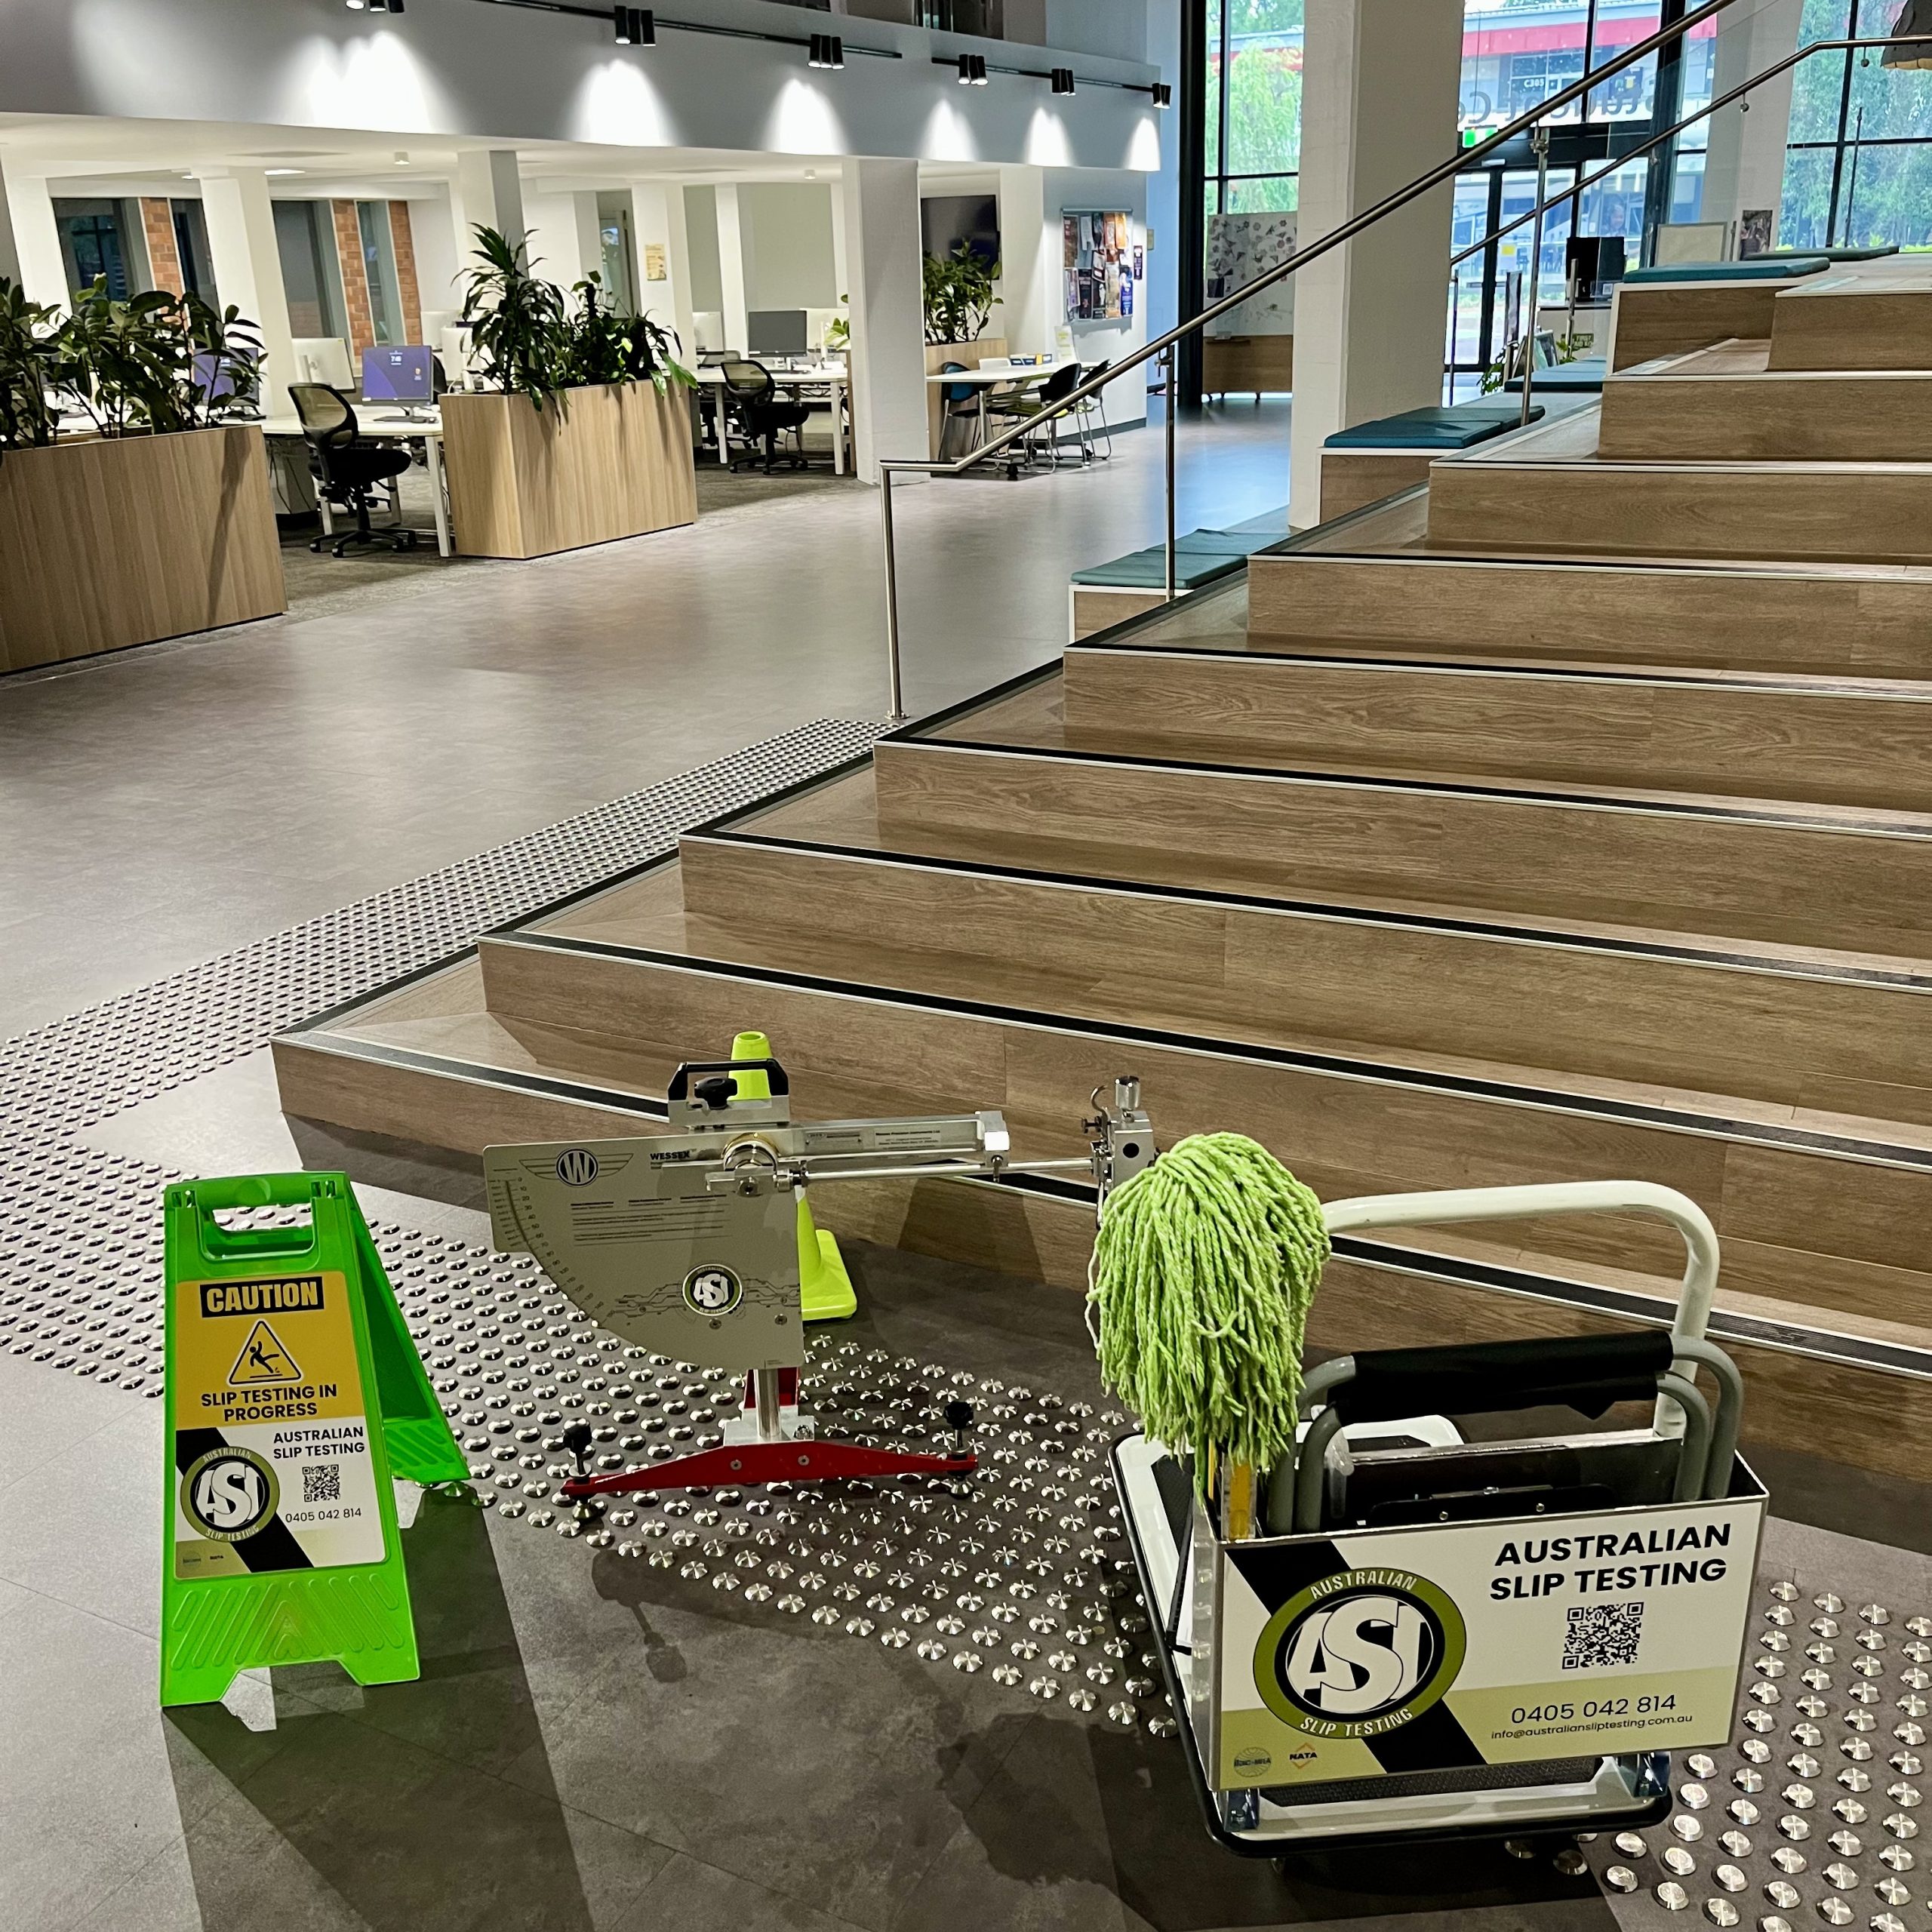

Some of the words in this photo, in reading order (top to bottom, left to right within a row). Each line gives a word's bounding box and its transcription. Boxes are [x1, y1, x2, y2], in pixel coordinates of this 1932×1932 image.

[650, 1150, 691, 1160] WESSEX
[206, 1281, 318, 1312] CAUTION
[201, 1392, 237, 1407] SLIP
[241, 1386, 315, 1404] TESTING
[319, 1383, 337, 1398] IN
[223, 1402, 318, 1422] PROGRESS
[273, 1426, 364, 1444] AUSTRALIAN
[202, 1448, 253, 1463] AUSTRALIAN
[273, 1447, 302, 1460] SLIP
[305, 1441, 365, 1457] TESTING
[285, 1510, 315, 1523] 0405
[318, 1509, 340, 1521] 042
[343, 1507, 362, 1518] 814
[205, 1527, 224, 1540] SLIP
[1494, 1523, 1731, 1567] AUSTRALIAN
[1309, 1570, 1418, 1600] AUSTRALIAN
[1490, 1572, 1565, 1601] SLIP
[1574, 1558, 1727, 1593] TESTING
[1511, 1703, 1575, 1724] 0405
[1583, 1698, 1629, 1718] 042
[1636, 1694, 1676, 1713] 814
[1300, 1716, 1337, 1736] SLIP
[1345, 1707, 1414, 1737] TESTING
[1491, 1714, 1693, 1740] info@australiansliptesting.com.au
[1289, 1751, 1318, 1761] NATA
